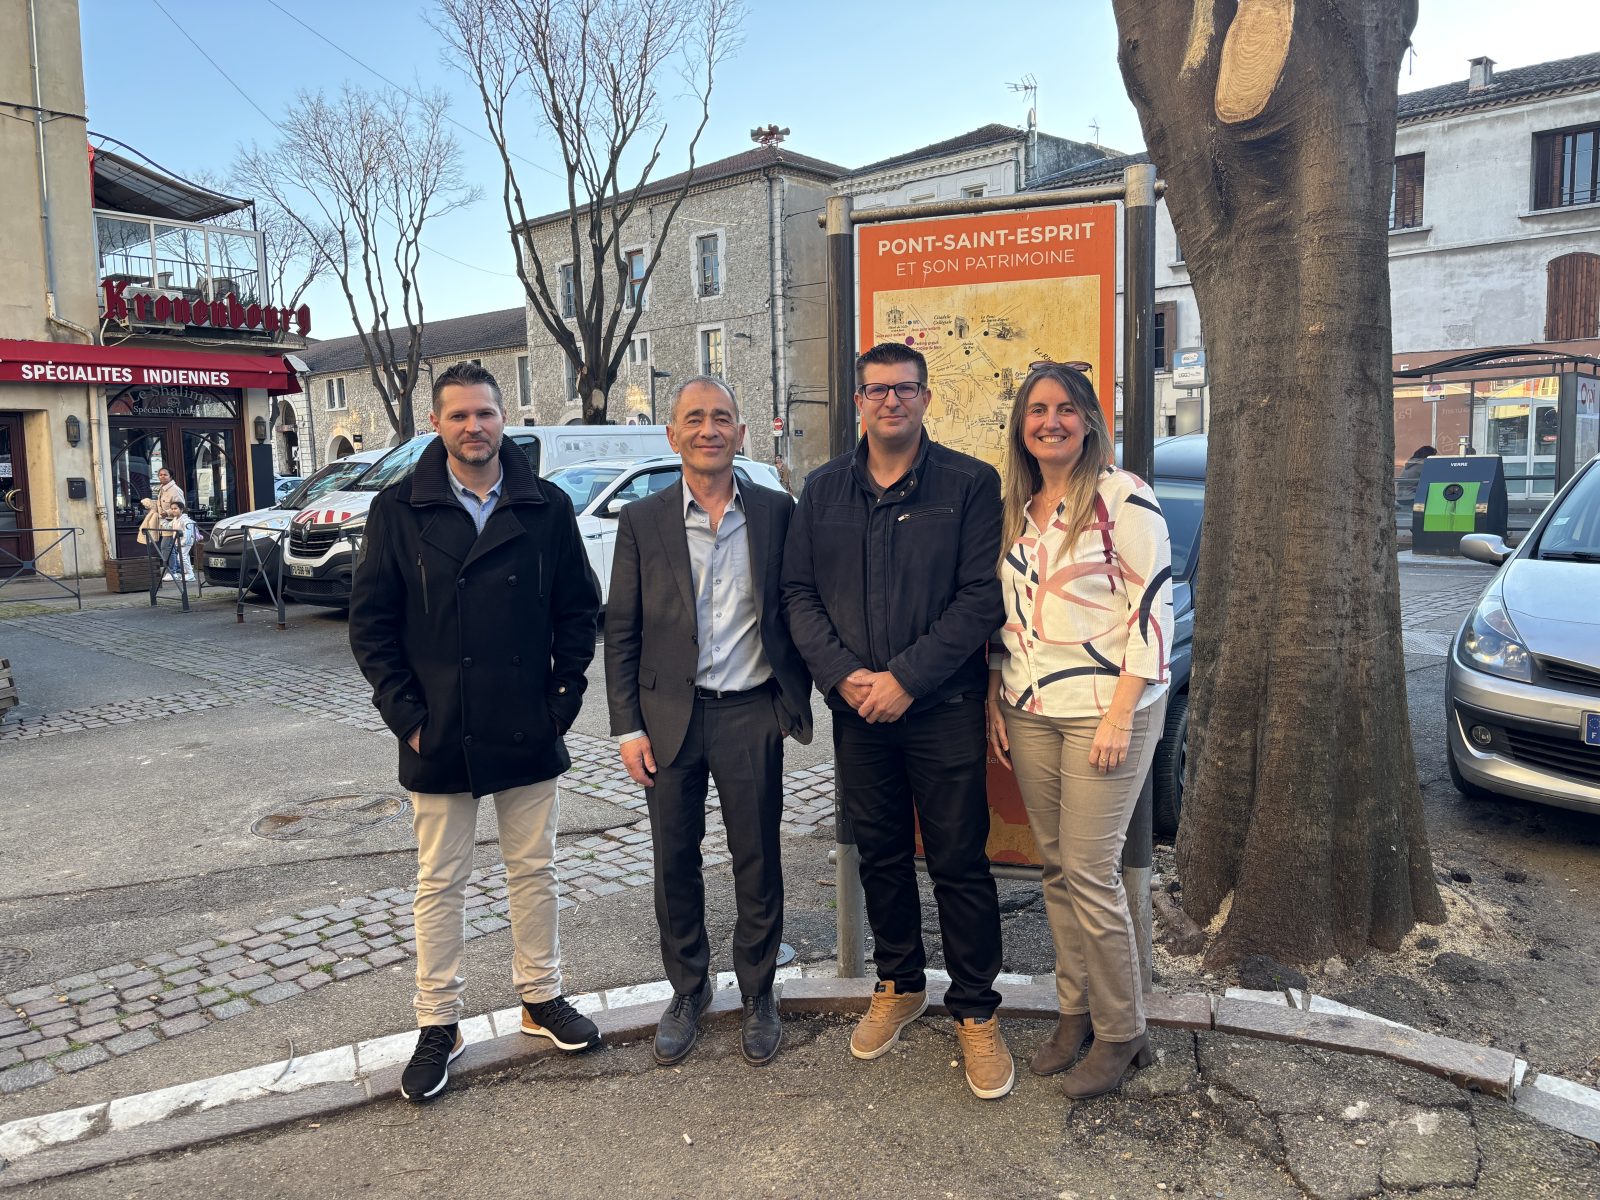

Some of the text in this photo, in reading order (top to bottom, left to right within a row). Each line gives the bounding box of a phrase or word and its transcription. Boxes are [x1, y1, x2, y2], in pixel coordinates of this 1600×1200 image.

[878, 222, 1095, 257] PONT-SAINT-ESPRIT
[896, 248, 1075, 276] ET SON PATRIMOINE
[101, 279, 312, 337] Kronenbourg
[143, 369, 230, 386] INDIENNES
[128, 390, 146, 403] Le
[1591, 732, 1597, 740] F
